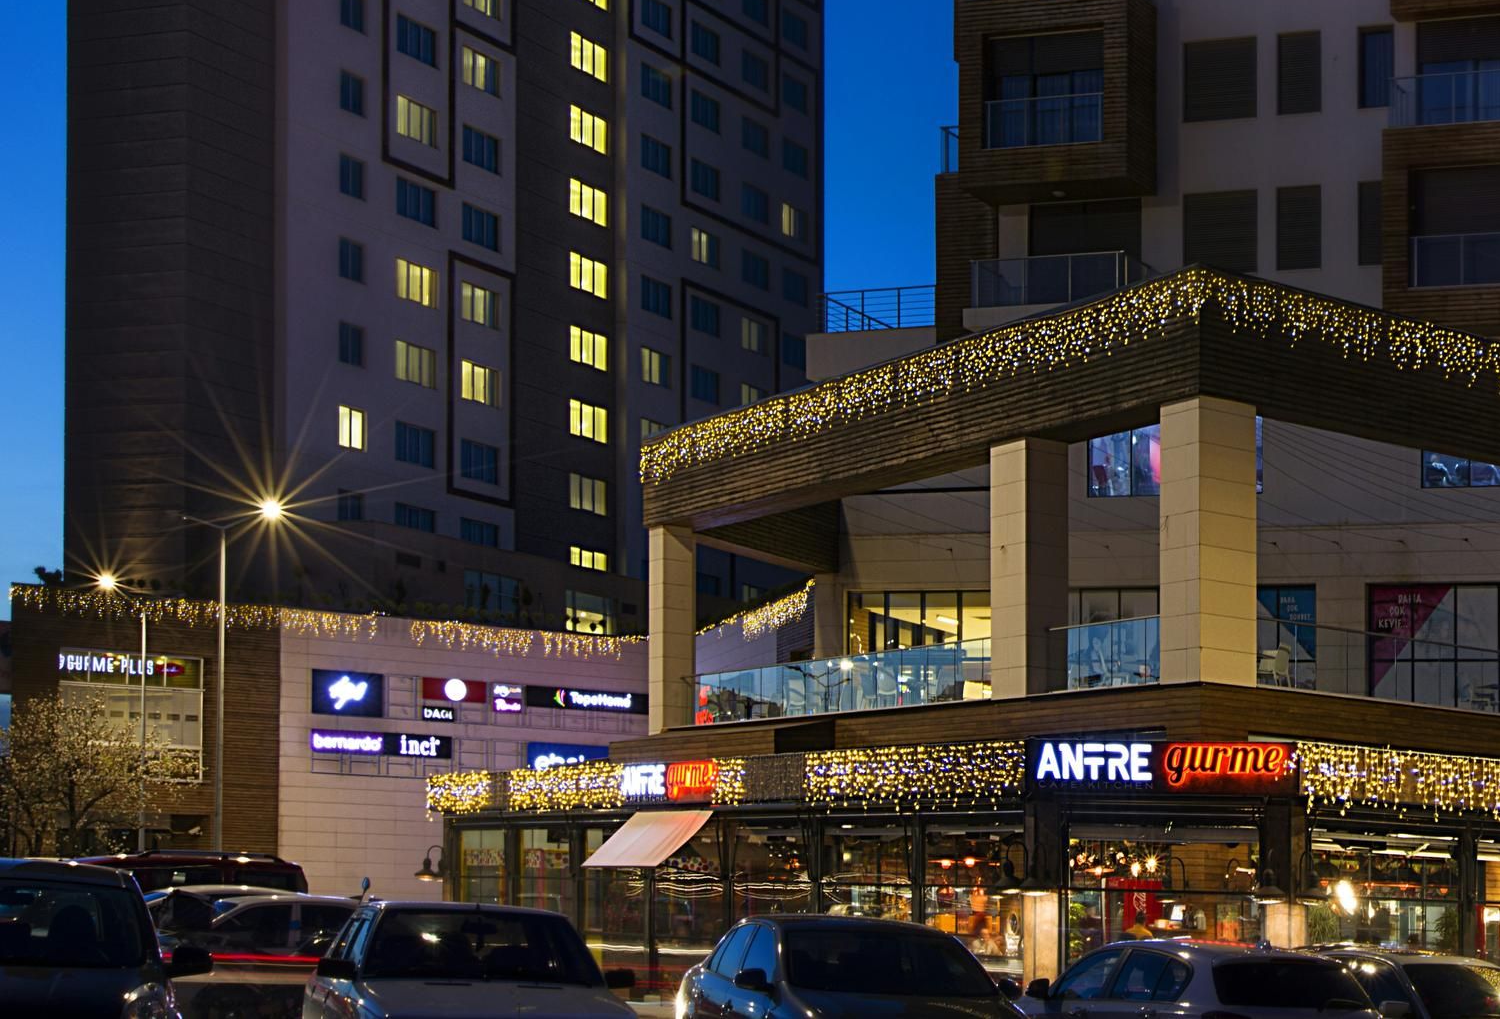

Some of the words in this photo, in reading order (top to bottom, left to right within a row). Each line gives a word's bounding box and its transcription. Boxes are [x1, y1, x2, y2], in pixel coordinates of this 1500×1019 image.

[313, 733, 383, 752] bernardo
[1036, 743, 1153, 782] ANTRE
[1164, 744, 1284, 786] gurme
[1087, 781, 1153, 790] KITCHEN
